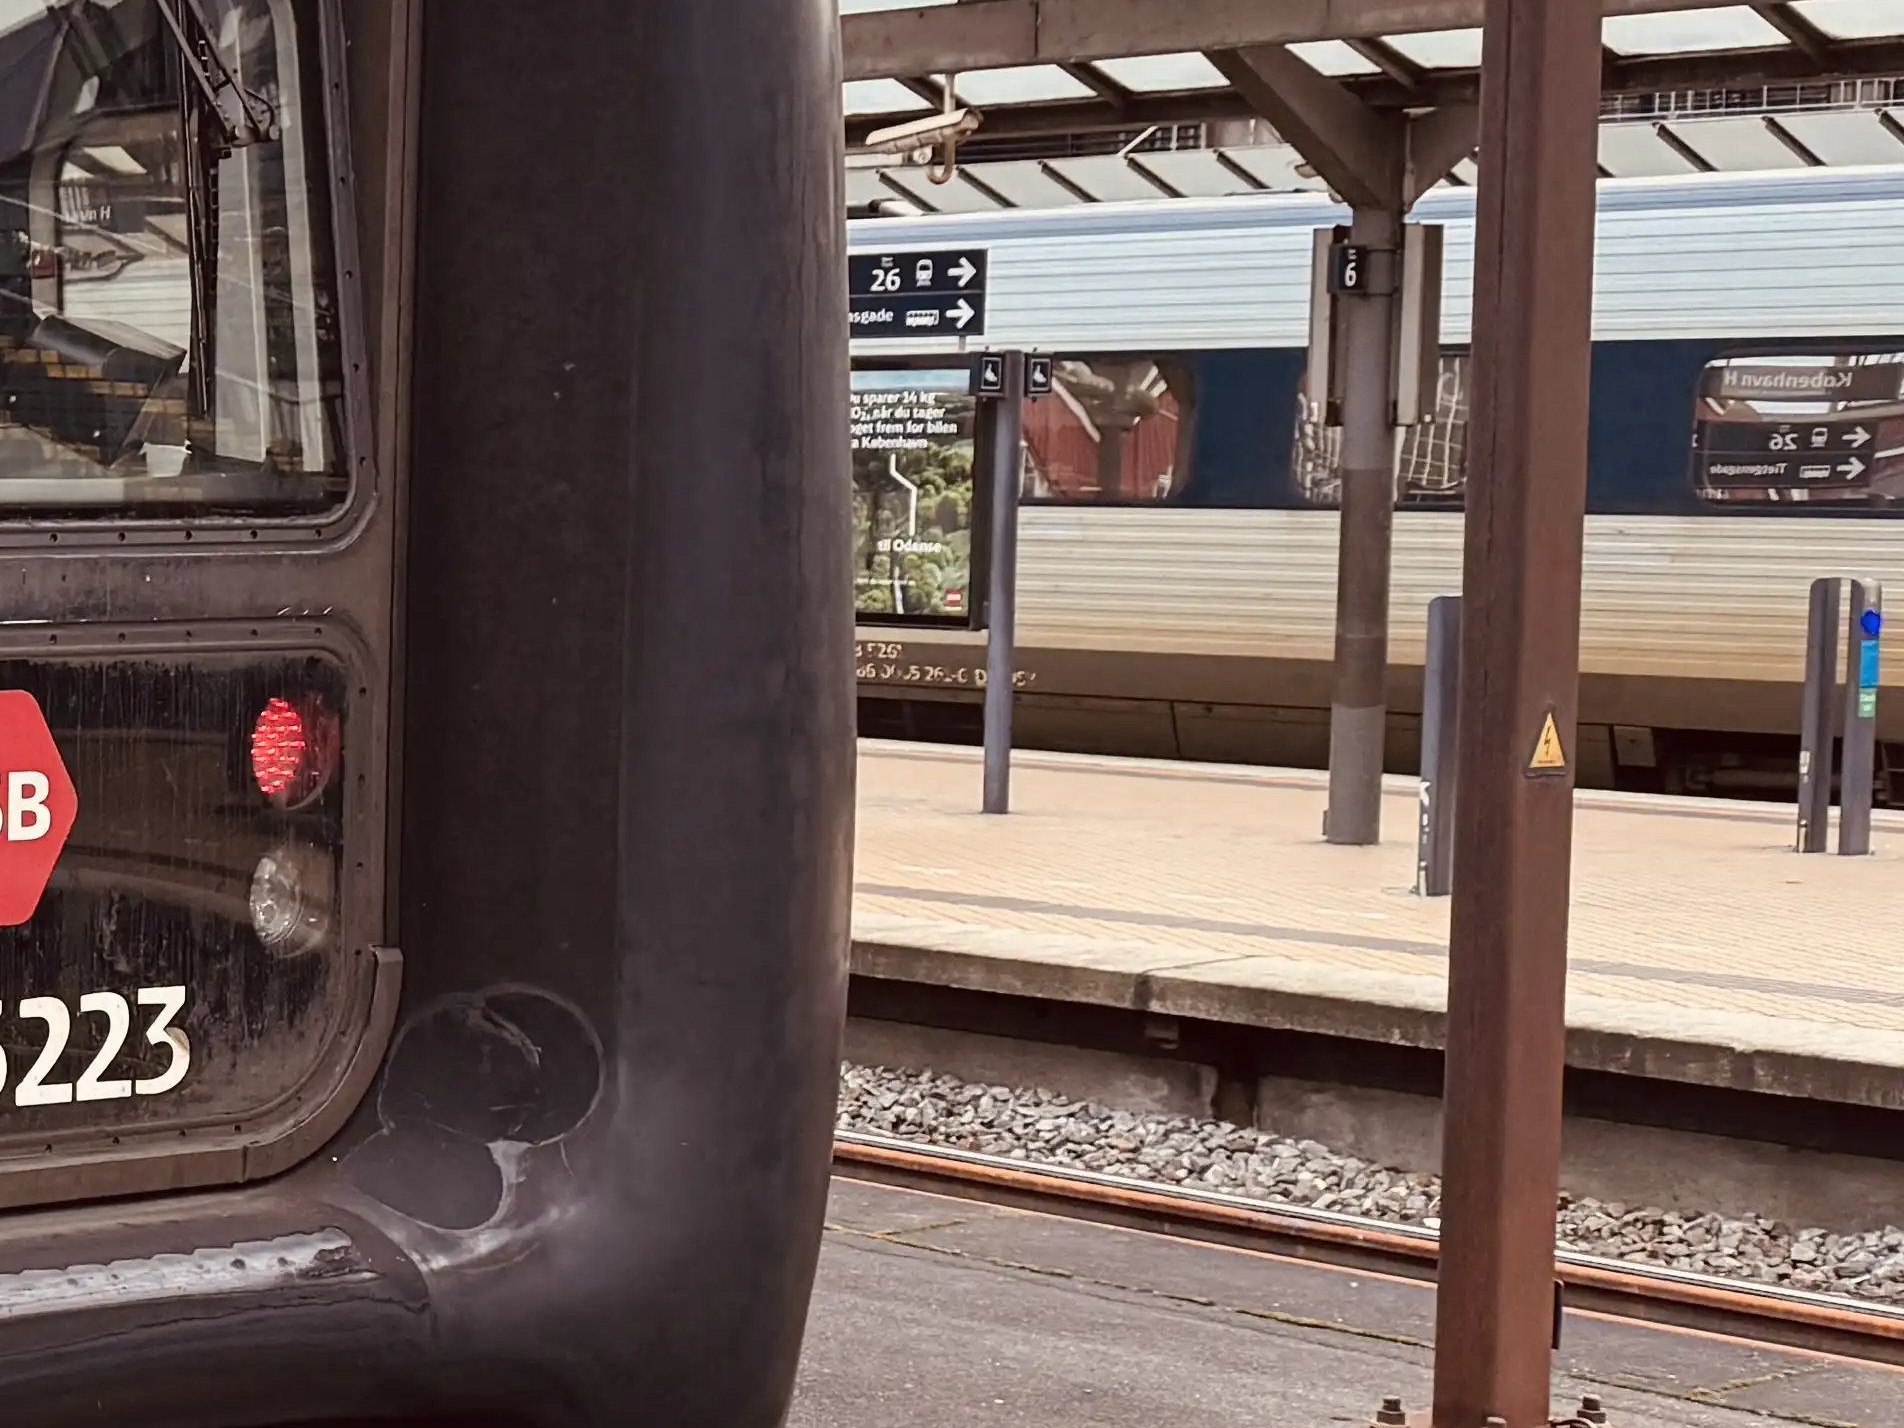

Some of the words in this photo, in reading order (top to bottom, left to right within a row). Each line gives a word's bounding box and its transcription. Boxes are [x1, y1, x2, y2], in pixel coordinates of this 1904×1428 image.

[870, 267, 901, 291] 26
[1345, 262, 1357, 287] 6
[848, 308, 894, 324] nsgade
